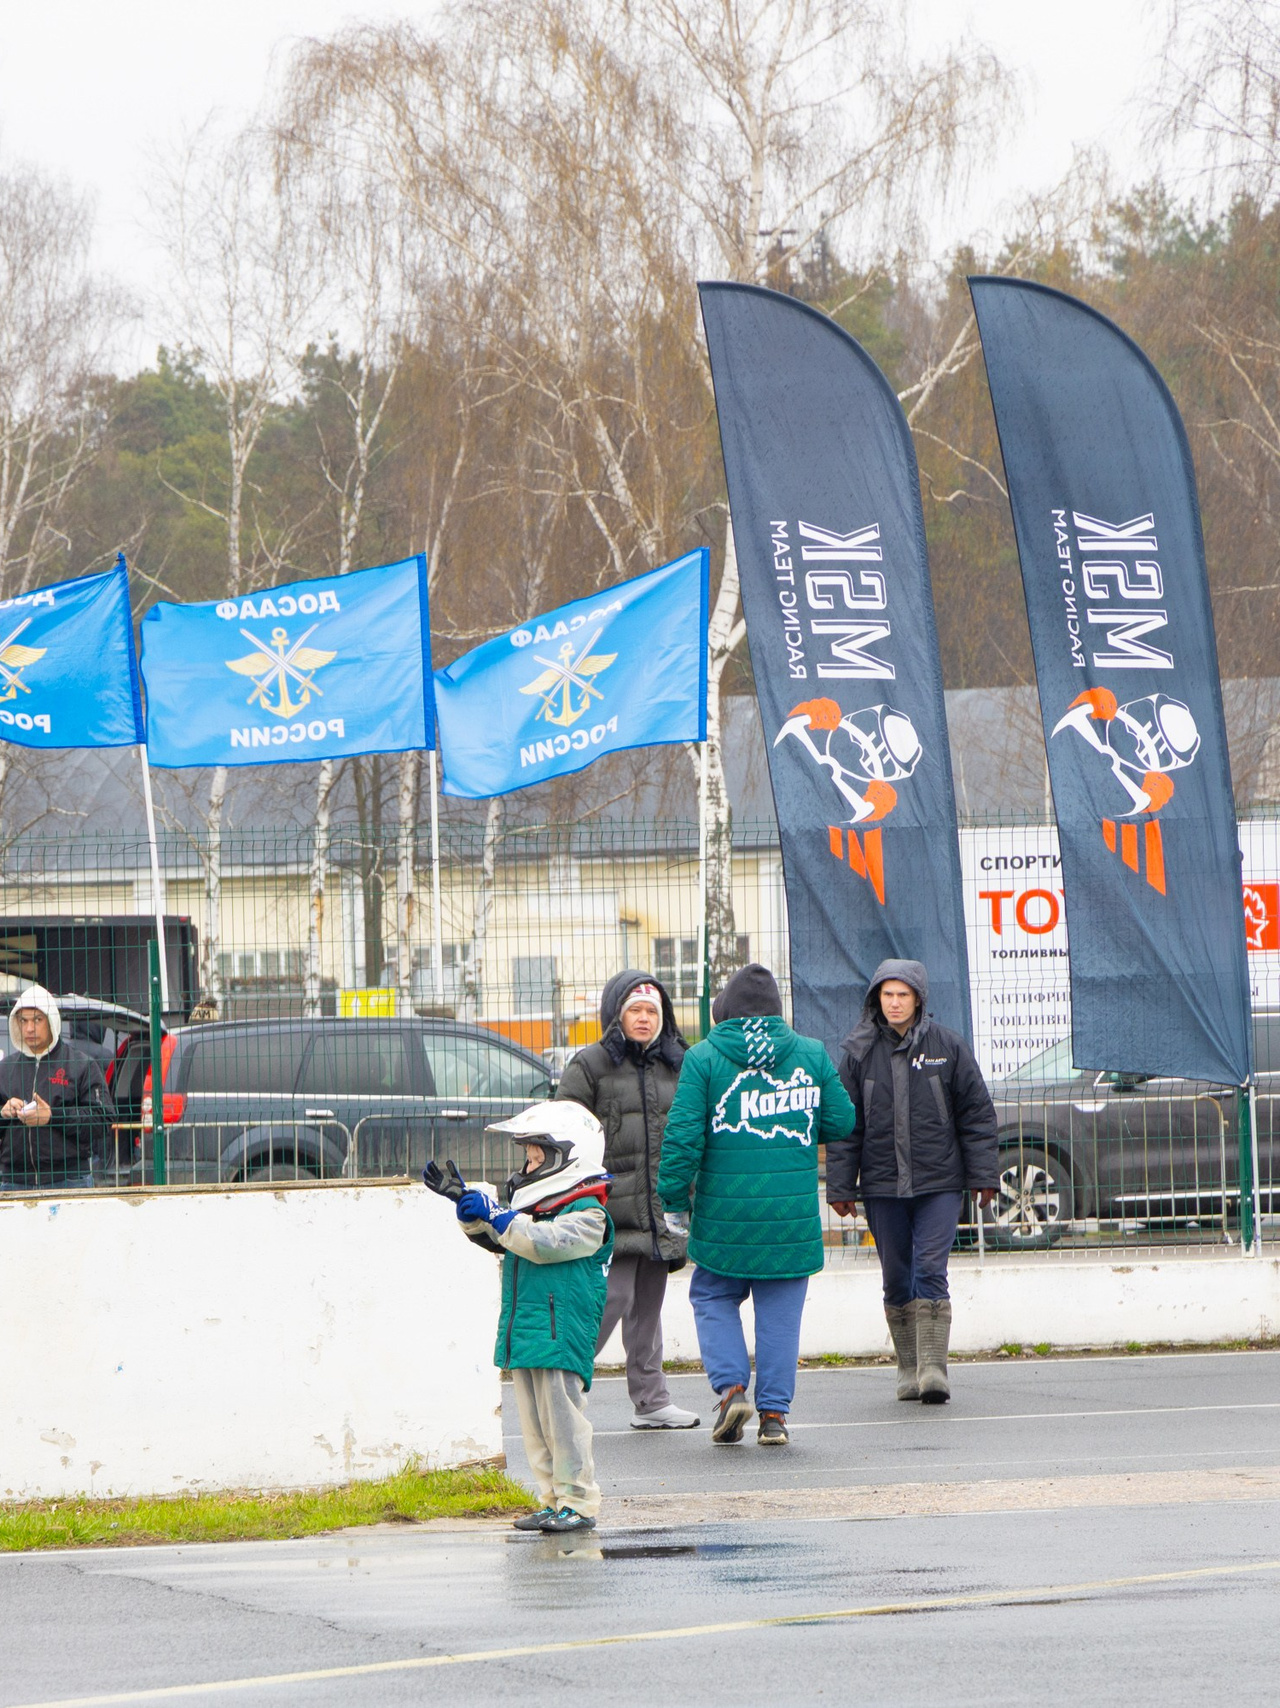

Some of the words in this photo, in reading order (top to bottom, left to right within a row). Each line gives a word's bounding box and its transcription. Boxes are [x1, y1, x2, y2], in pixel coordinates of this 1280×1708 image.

[990, 991, 1071, 1005] АНТИФРИ
[991, 1014, 1071, 1027] ТОПЛИВН
[740, 1085, 821, 1120] Kazan
